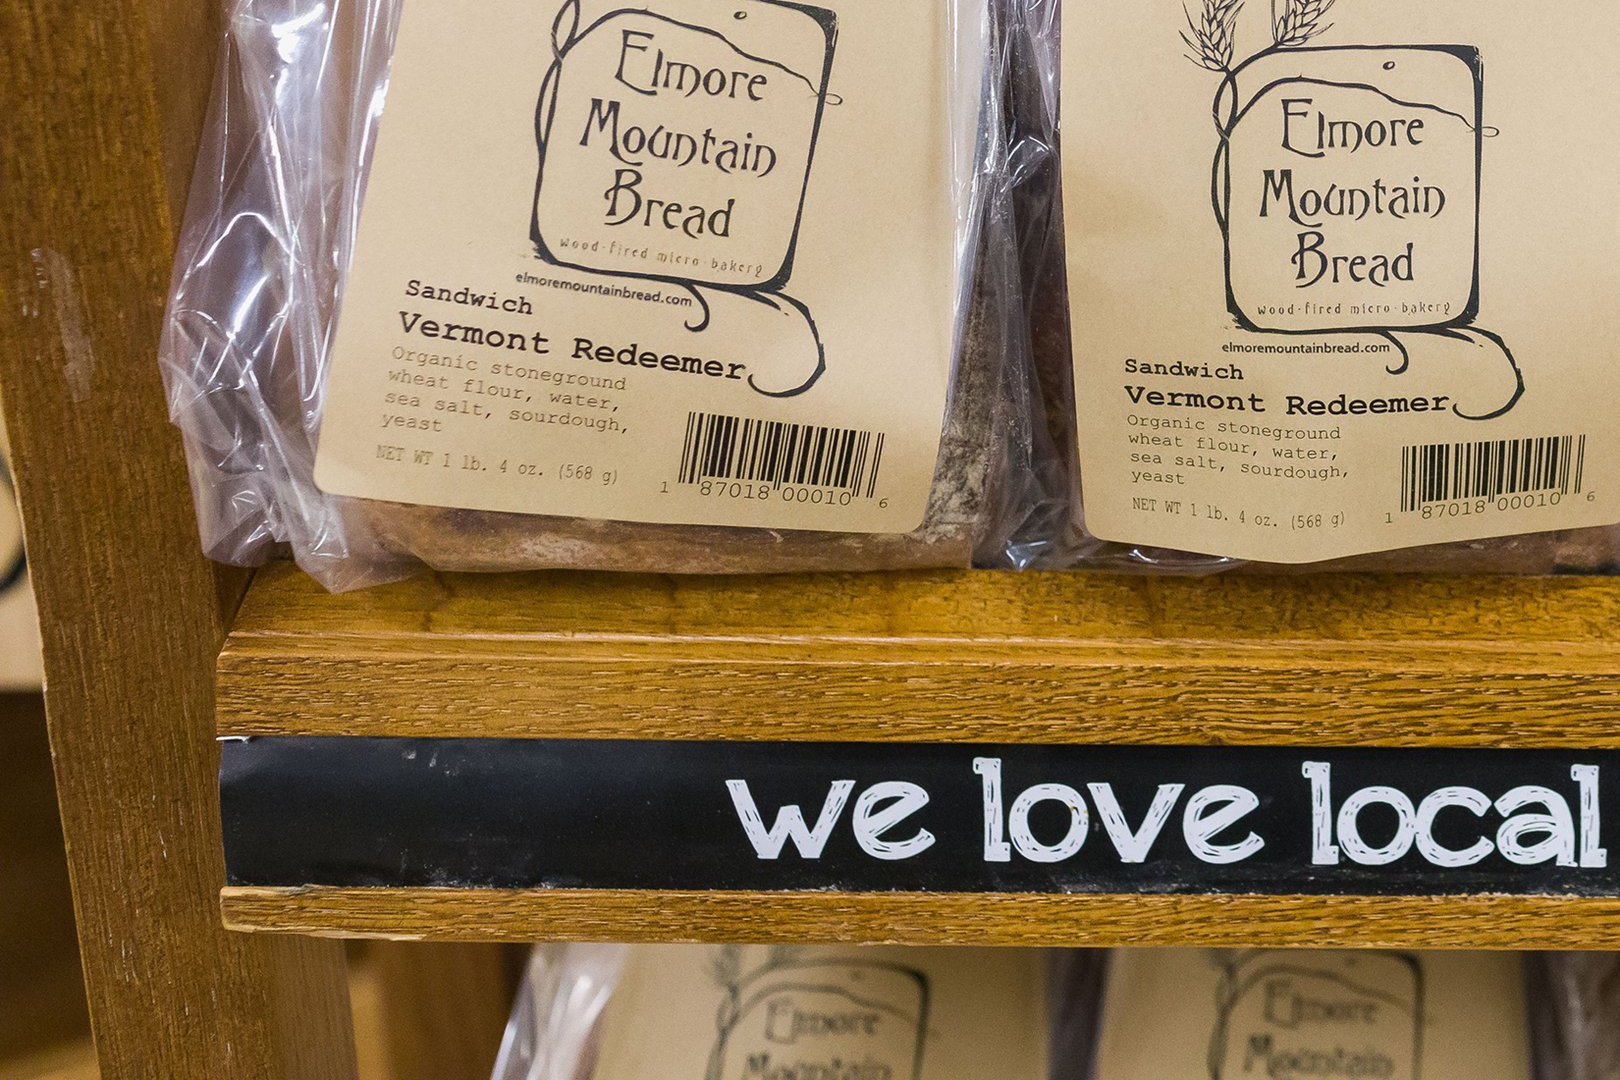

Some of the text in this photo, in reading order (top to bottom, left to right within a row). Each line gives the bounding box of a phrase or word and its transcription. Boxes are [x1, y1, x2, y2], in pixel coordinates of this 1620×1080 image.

[614, 29, 767, 101] Elmore
[579, 98, 776, 178] Mountain
[1281, 98, 1424, 158] Elmore
[604, 169, 735, 239] Bread
[1259, 169, 1445, 226] Mountain
[1291, 231, 1414, 288] Bread
[405, 280, 532, 315] Sandwich
[516, 272, 692, 307] elmoremountainbread.com
[399, 311, 746, 379] Vermont Redeemer
[1222, 342, 1390, 353] elmoremountainbread.com
[392, 346, 626, 390] Organic stoneground
[1125, 359, 1244, 380] Sandwich
[389, 369, 618, 412] wheat flour, water,
[1124, 386, 1449, 415] Vermont Redeemer
[381, 415, 442, 432] yeast
[385, 393, 627, 434] sea salt, sourdough,
[1127, 414, 1341, 441] Organic stoneground
[1128, 433, 1336, 461] wheat flour, water,
[1131, 453, 1347, 481] sea salt, sourdough,
[1132, 471, 1184, 484] yeast
[700, 481, 851, 506] 87018 00010
[1422, 492, 1560, 519] 87018 00010
[726, 757, 1607, 868] we love local
